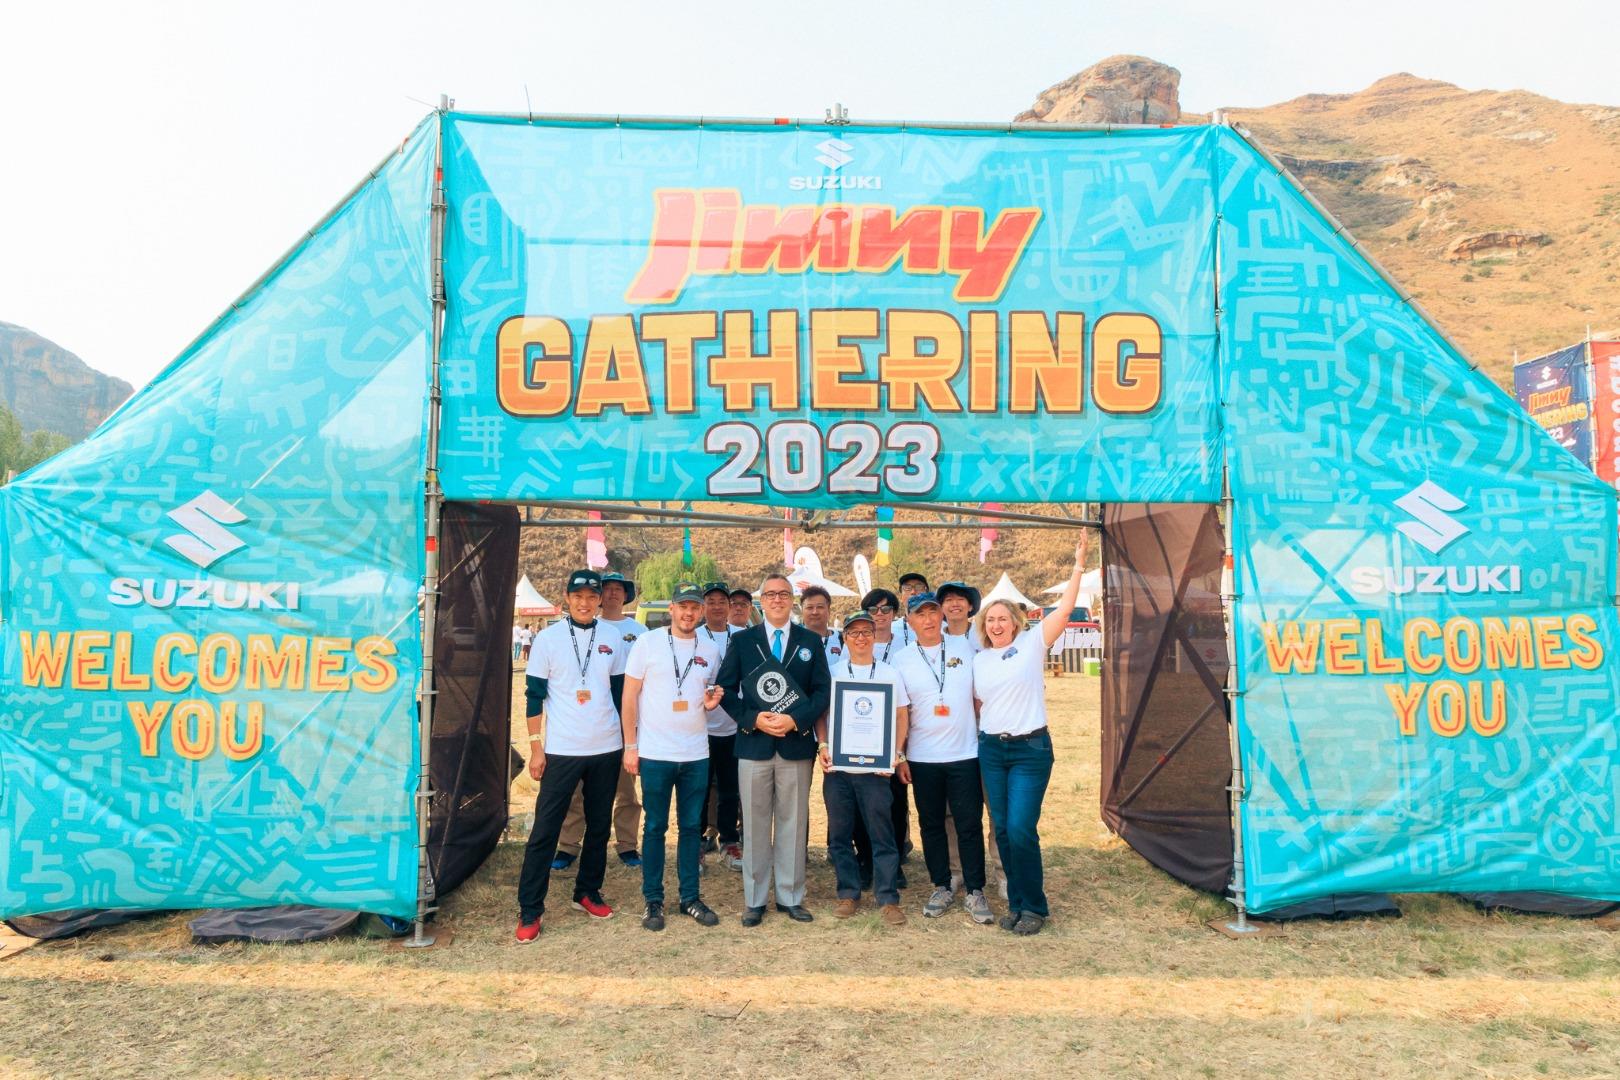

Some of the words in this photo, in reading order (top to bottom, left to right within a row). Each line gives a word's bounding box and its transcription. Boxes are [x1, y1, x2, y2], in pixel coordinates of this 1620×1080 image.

[789, 176, 881, 190] SUZUKI
[496, 309, 1163, 417] GATHERING
[705, 421, 941, 496] 2023
[108, 577, 300, 610] SUZUKI
[1350, 565, 1522, 595] SUZUKI
[20, 630, 398, 693] WELCOMES
[1263, 614, 1604, 675] WELCOMES
[128, 699, 264, 761] YOU
[770, 690, 796, 712] OFFICIALLY
[1384, 679, 1507, 737] YOU
